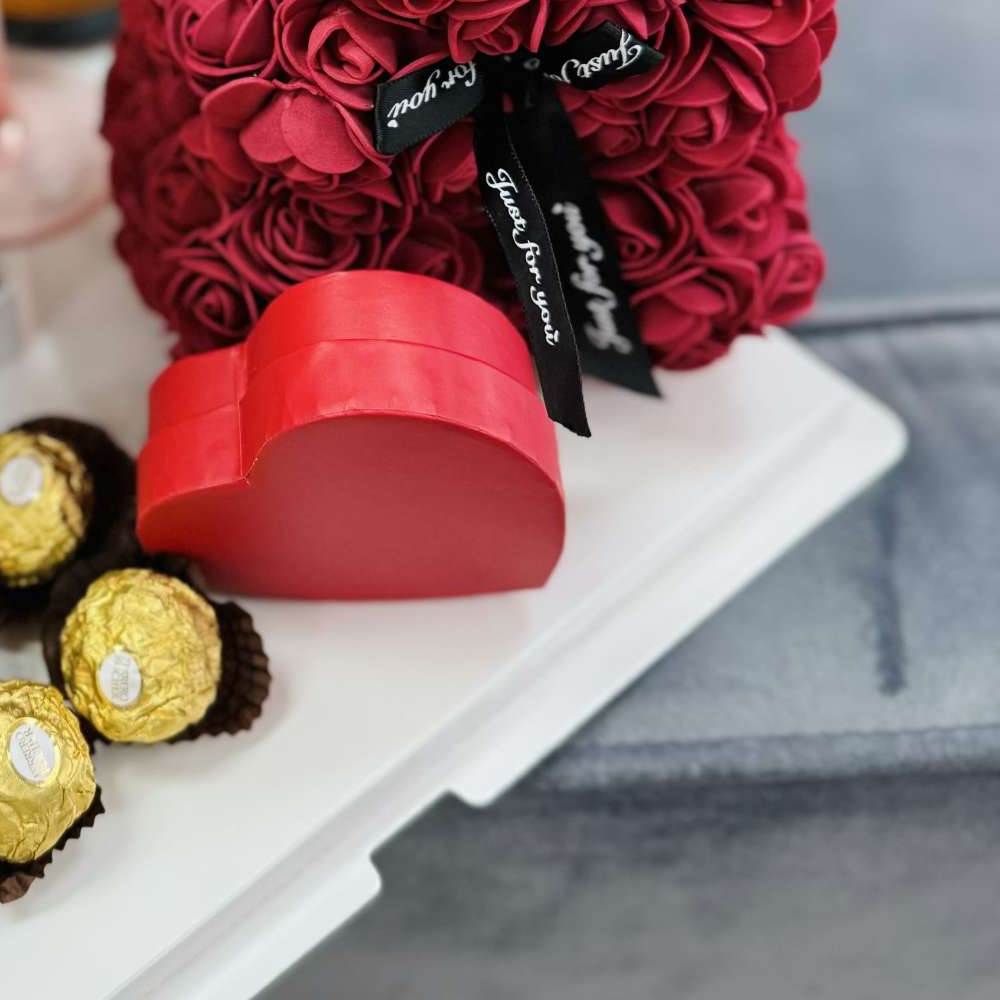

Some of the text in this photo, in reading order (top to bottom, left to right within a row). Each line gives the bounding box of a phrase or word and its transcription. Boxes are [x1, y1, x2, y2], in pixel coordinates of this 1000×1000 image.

[576, 28, 642, 79] Just
[386, 60, 477, 120] for you
[485, 167, 558, 346] Just for you
